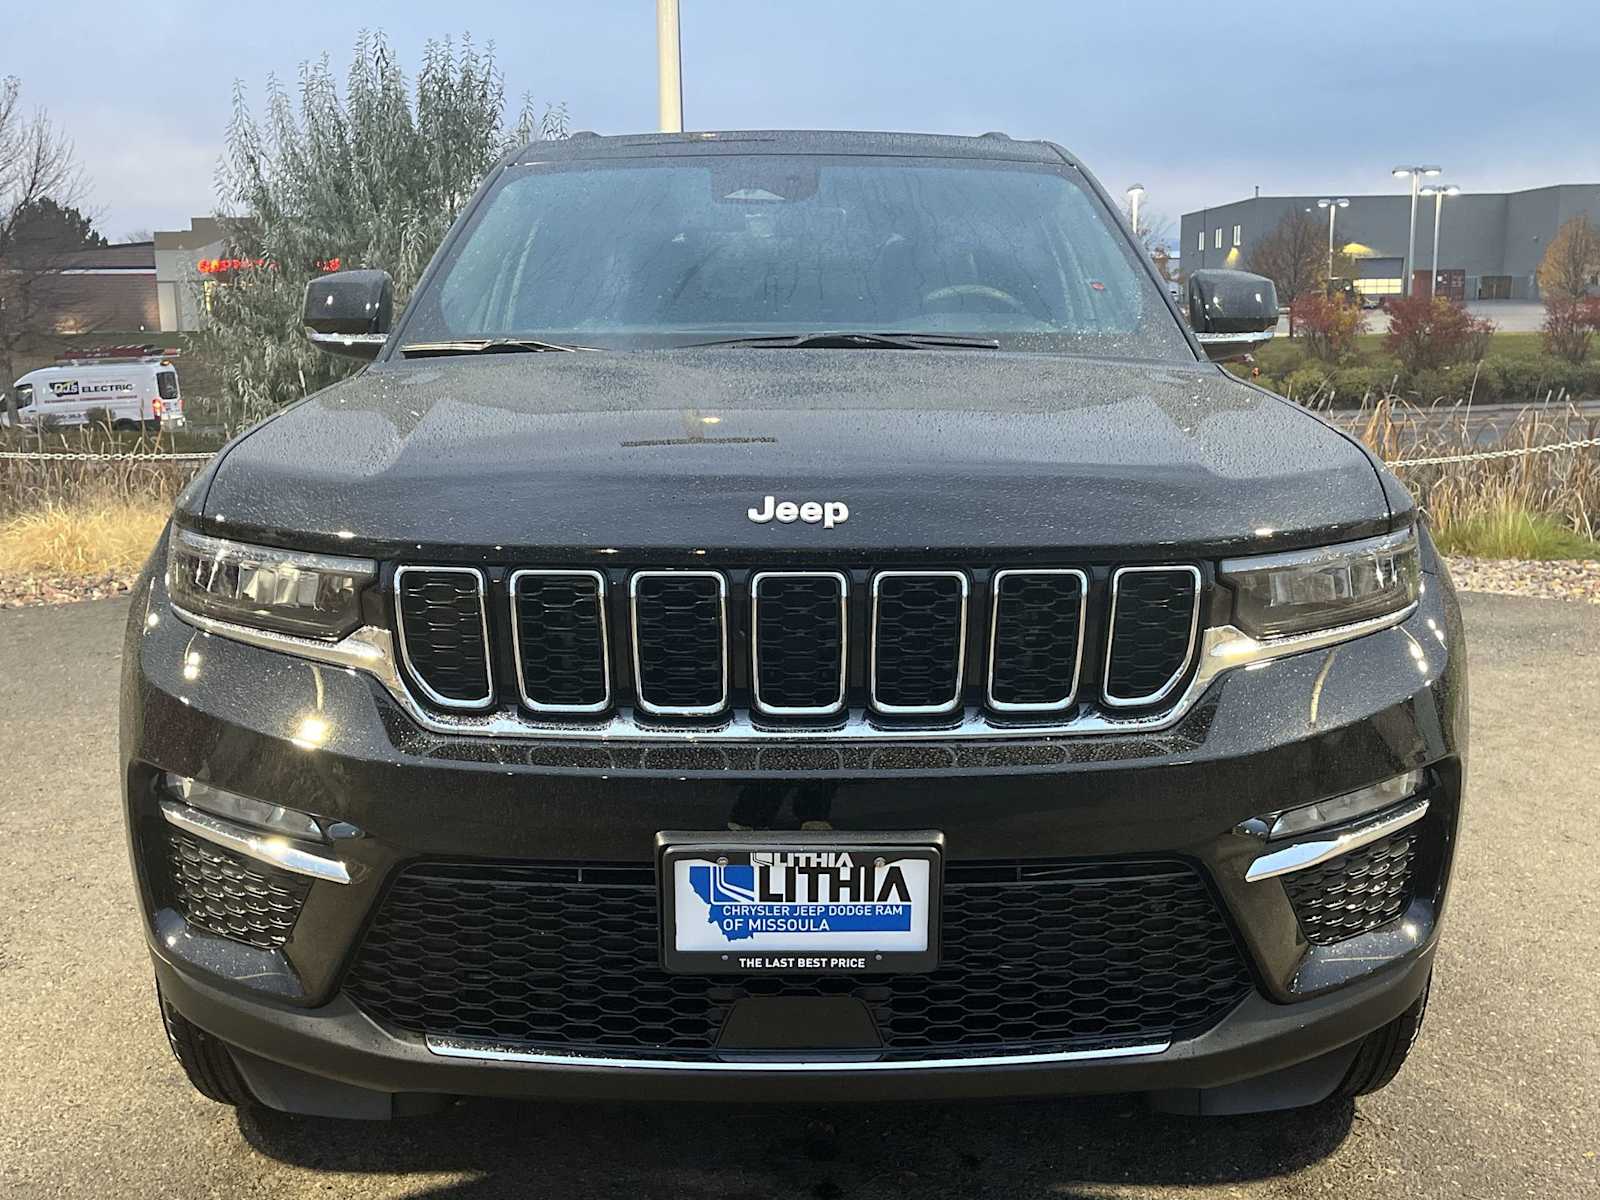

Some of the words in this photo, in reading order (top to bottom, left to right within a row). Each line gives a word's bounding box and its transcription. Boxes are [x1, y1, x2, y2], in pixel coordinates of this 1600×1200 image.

[82, 384, 133, 393] ELECTRIC
[748, 496, 849, 528] Jeep
[773, 852, 854, 868] LITHIA
[759, 866, 912, 902] LITHIA
[722, 905, 789, 916] CHRYSLER
[793, 905, 824, 916] JEEP
[828, 905, 872, 916] DODGE
[876, 905, 903, 916] RAM
[722, 918, 743, 931] OF
[748, 918, 830, 931] MISSOULA
[739, 958, 762, 968] THE
[765, 958, 795, 968] LAST
[797, 958, 827, 968] BEST
[830, 958, 866, 968] PRICE
